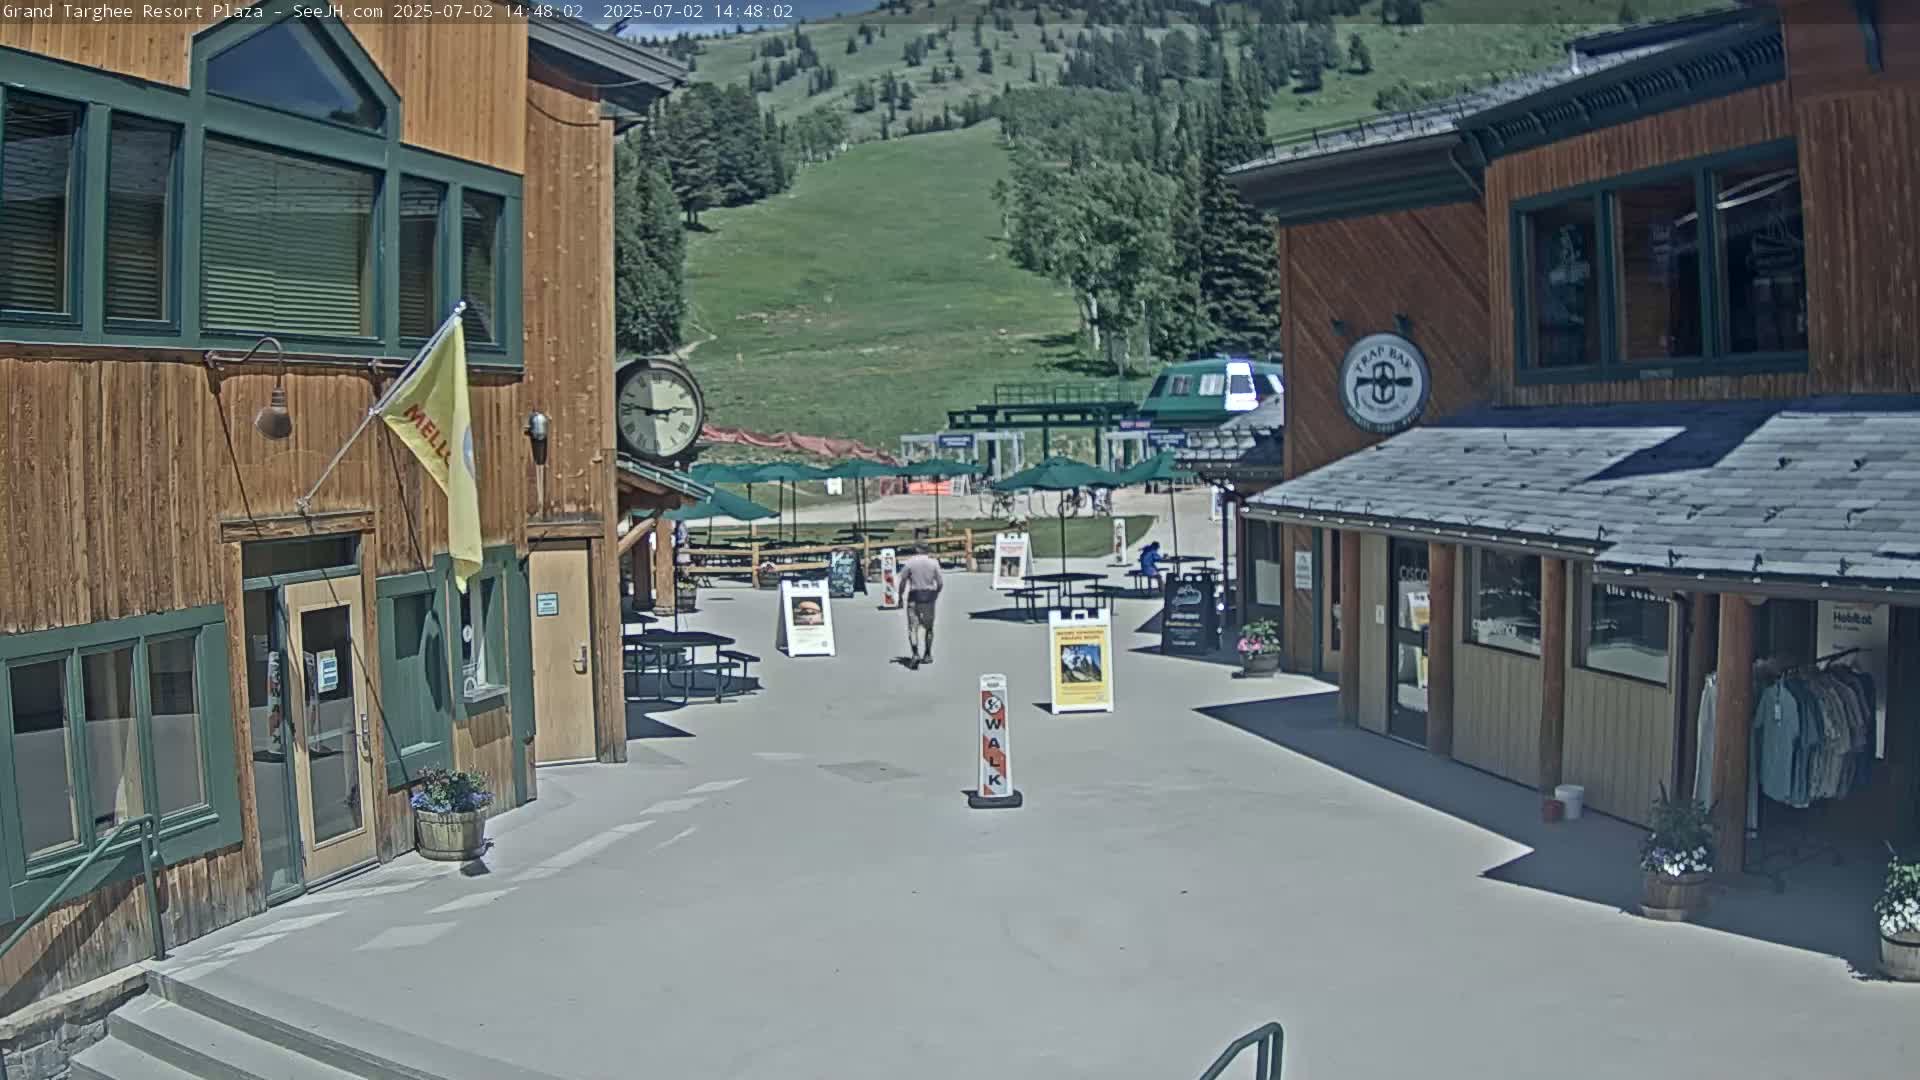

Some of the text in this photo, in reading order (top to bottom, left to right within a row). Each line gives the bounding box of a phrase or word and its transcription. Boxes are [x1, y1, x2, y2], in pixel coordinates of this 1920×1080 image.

[1354, 346, 1413, 373] TRAP BAR
[985, 718, 1002, 786] WALK
